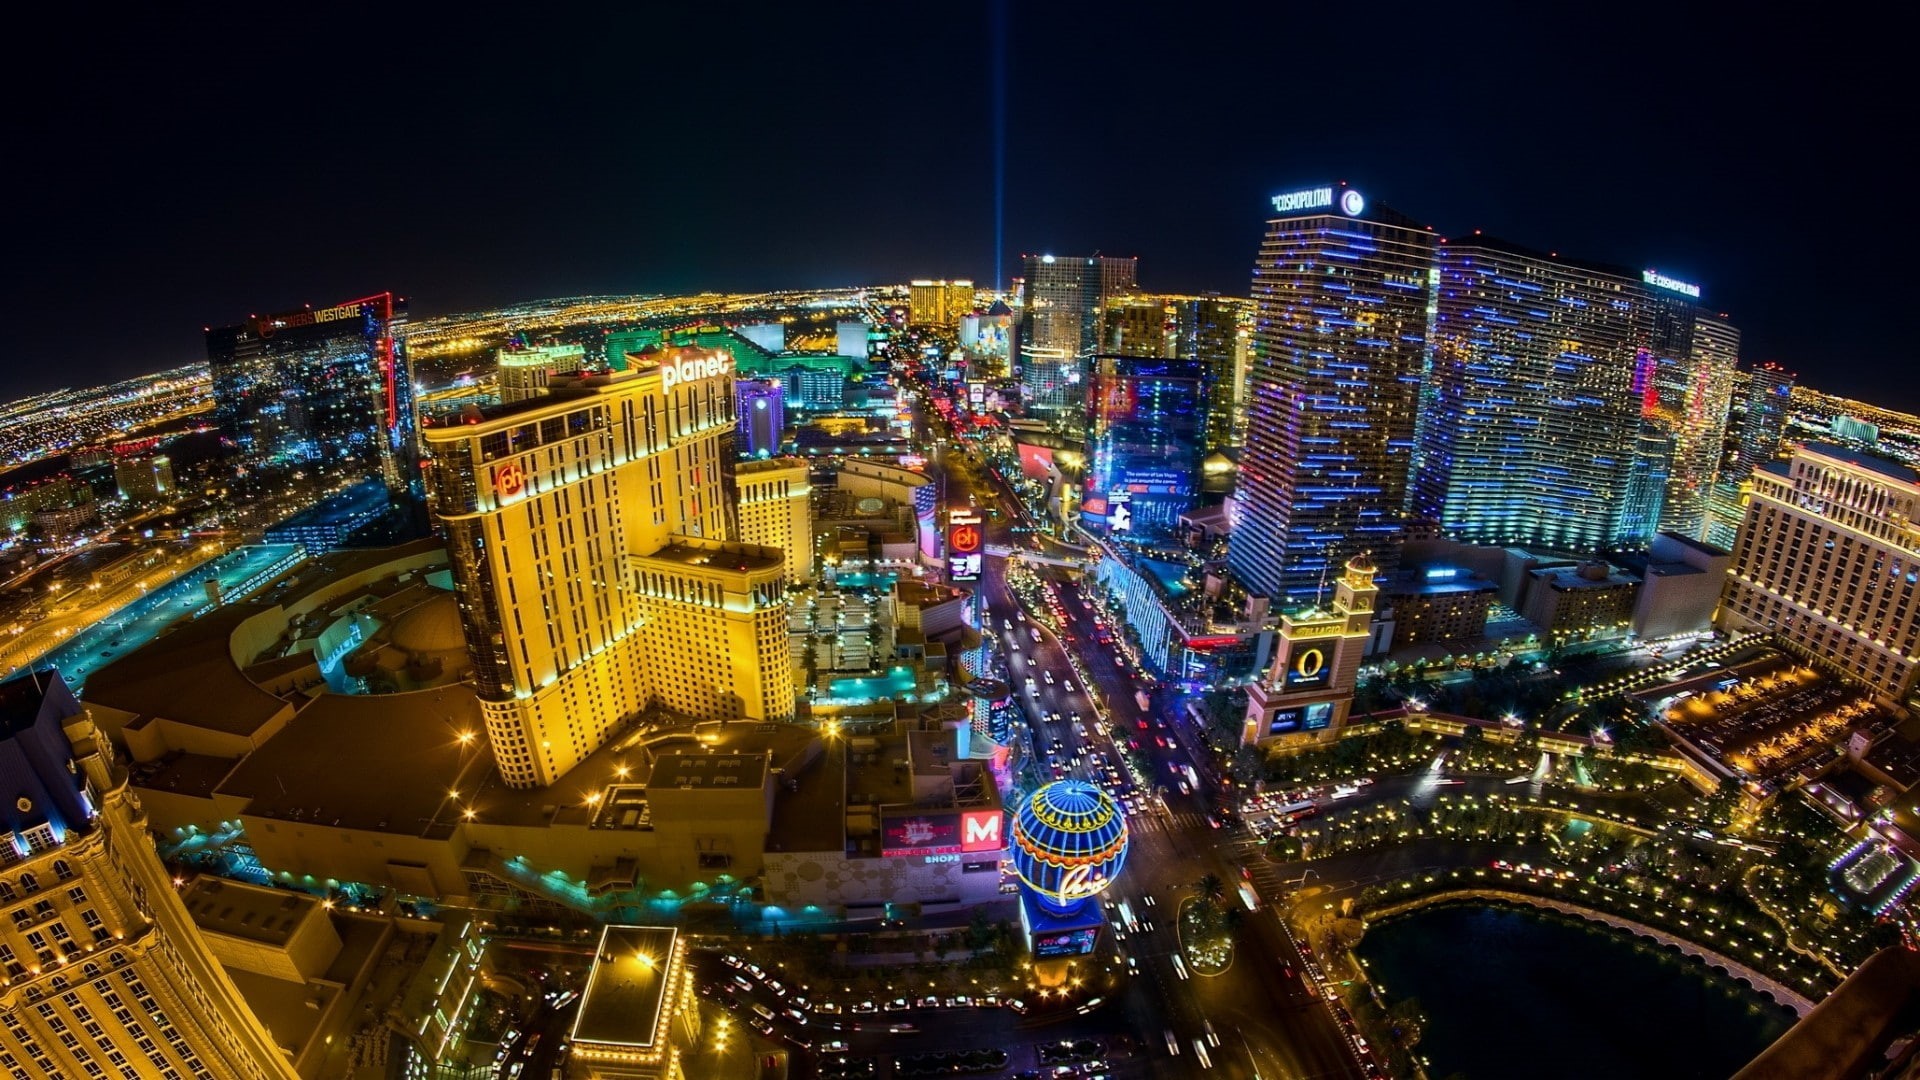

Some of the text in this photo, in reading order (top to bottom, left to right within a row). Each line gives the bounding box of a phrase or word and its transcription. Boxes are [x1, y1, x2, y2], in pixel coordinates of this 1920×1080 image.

[1278, 188, 1332, 211] COSMOPOLITAN
[1657, 274, 1700, 297] COSMOPOLITAN
[314, 304, 361, 323] WESTGATE
[662, 351, 729, 395] planet
[499, 464, 522, 495] ph
[966, 815, 999, 843] M
[925, 854, 960, 863] SHOPS
[1060, 864, 1107, 907] Paris
